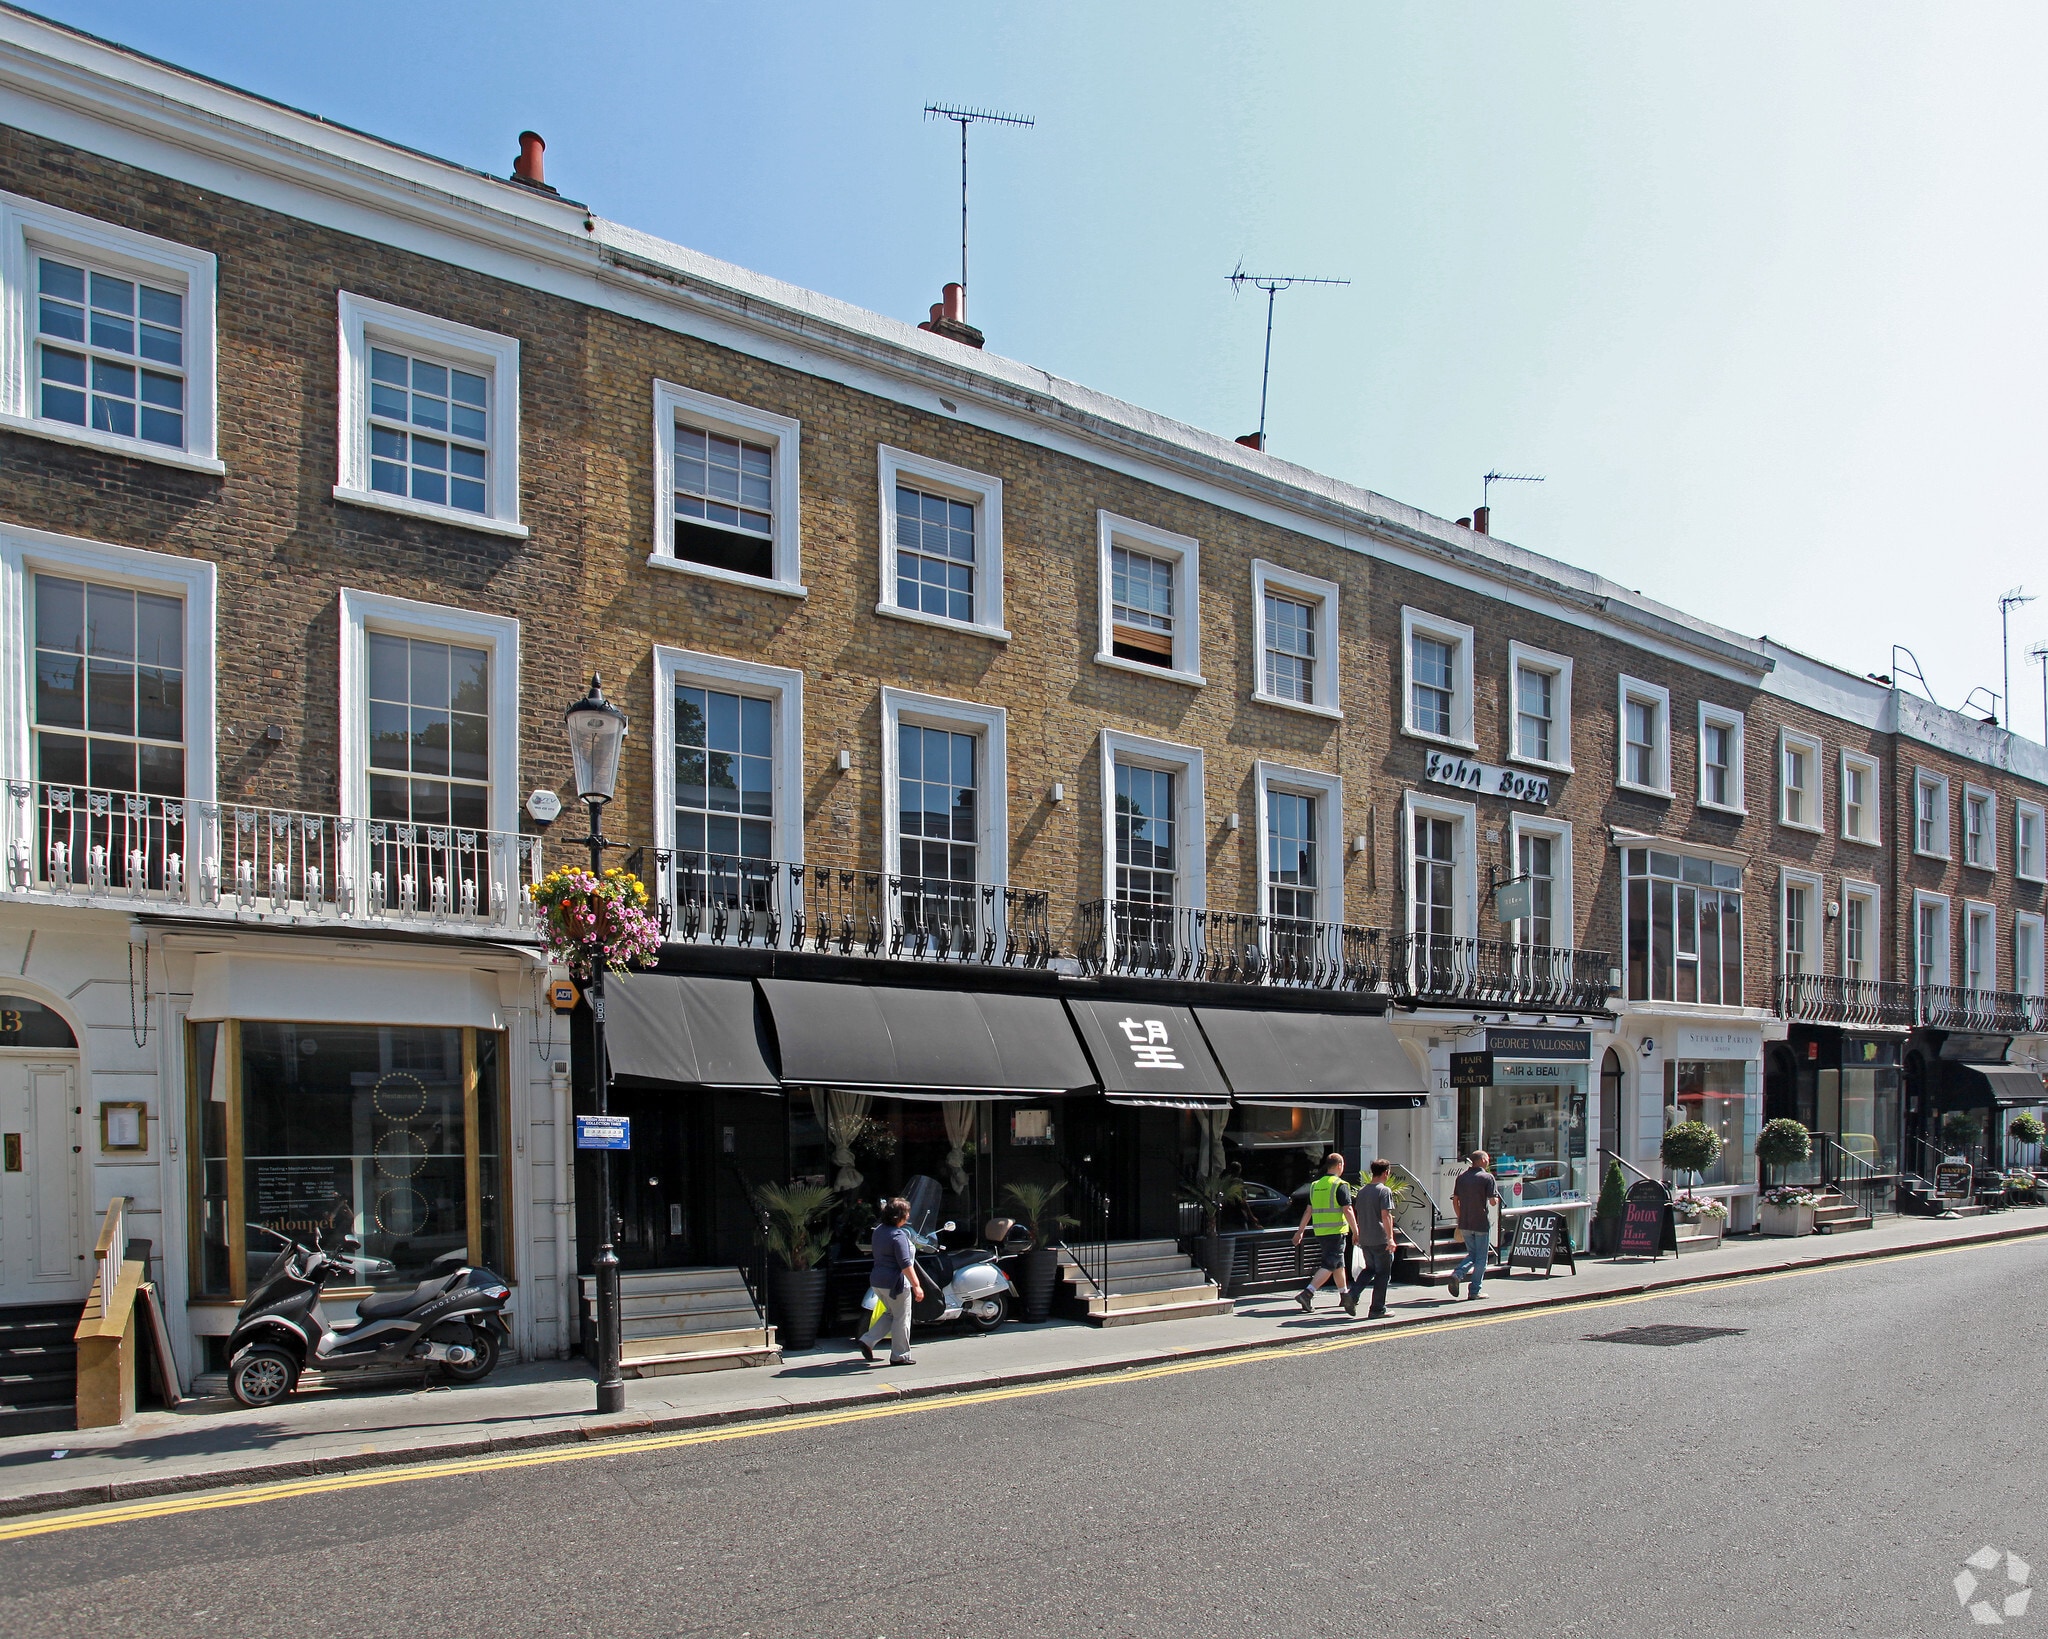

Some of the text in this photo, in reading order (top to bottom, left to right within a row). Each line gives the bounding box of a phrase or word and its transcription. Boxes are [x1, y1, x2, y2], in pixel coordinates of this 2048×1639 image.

[557, 991, 572, 999] ADT
[1118, 1017, 1185, 1070] 望
[1489, 1037, 1587, 1051] GEORGE VALLOSSIAN
[1460, 1055, 1482, 1065] HAIR
[1502, 1066, 1524, 1076] HAIR
[1527, 1066, 1534, 1076] &
[1439, 1077, 1449, 1089] 16
[1453, 1074, 1490, 1084] BEAUTY
[1411, 1097, 1421, 1107] 15
[259, 1217, 335, 1235] galoupet
[1522, 1216, 1556, 1231] SALE
[1520, 1231, 1551, 1246] HATS
[1623, 1229, 1647, 1239] Hair
[1513, 1246, 1551, 1258] DOWNSTAIRS
